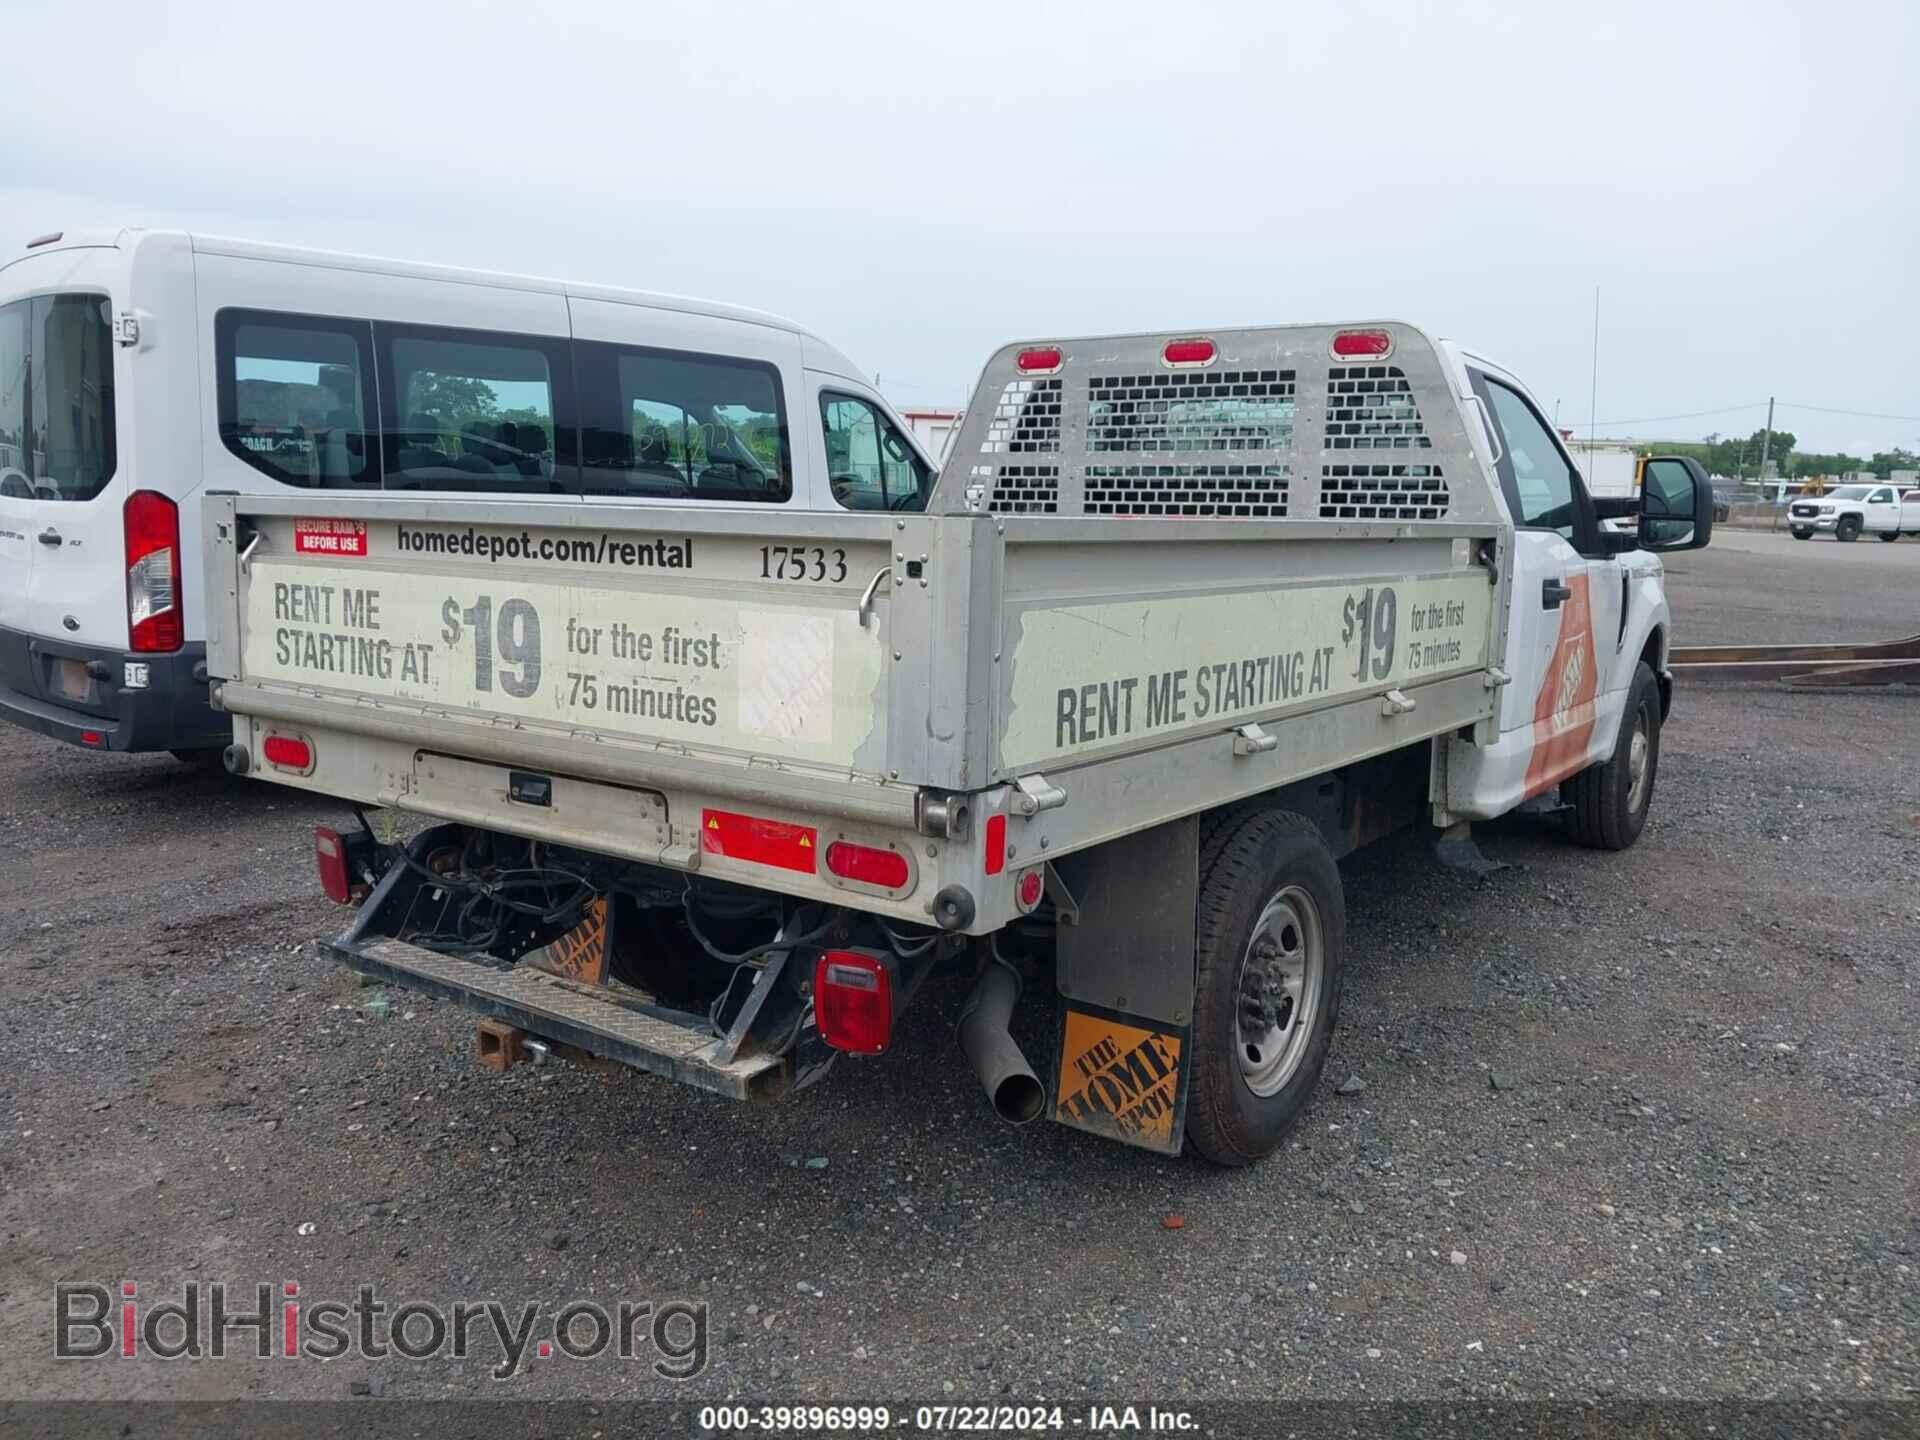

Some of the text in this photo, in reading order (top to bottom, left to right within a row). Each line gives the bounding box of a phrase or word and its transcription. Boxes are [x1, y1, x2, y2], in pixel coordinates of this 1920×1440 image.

[296, 519, 331, 533] SECURE
[303, 535, 359, 551] BEFORE USE
[397, 525, 692, 568] homedepot.com/rental
[759, 545, 848, 582] 17533
[274, 582, 380, 630] RENT ME
[1411, 600, 1464, 632] for the first
[276, 627, 434, 684] STARTING AT
[441, 595, 541, 698] $19
[566, 618, 721, 669] for the first
[1342, 588, 1396, 682] $19
[1409, 636, 1461, 669] 75 minutes
[567, 672, 717, 727] 75 minutes
[1056, 646, 1335, 748] RENT ME STARTING AT
[1073, 1035, 1122, 1078] THE
